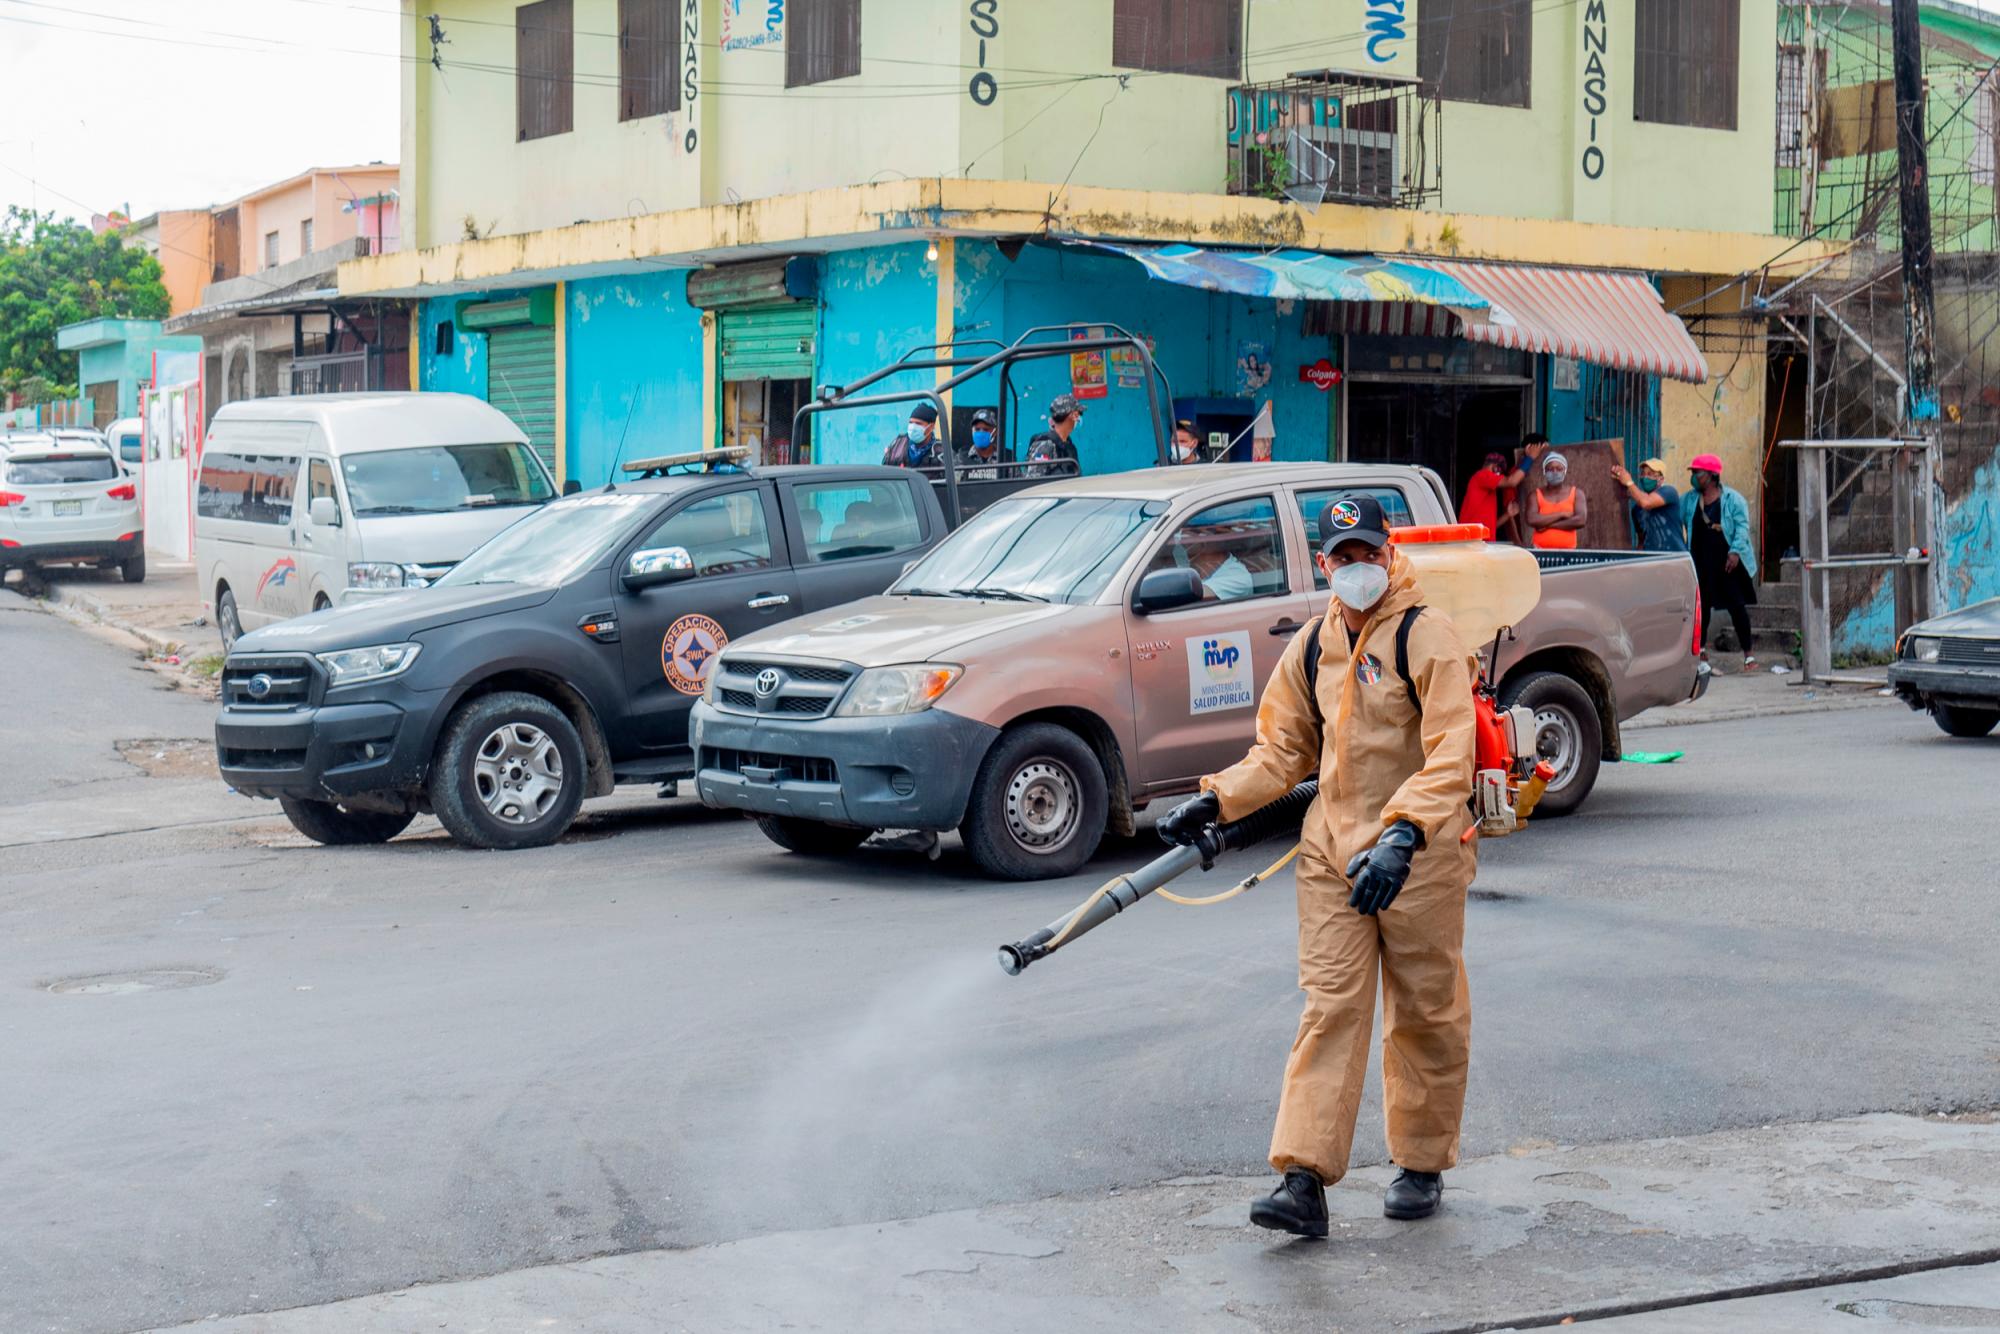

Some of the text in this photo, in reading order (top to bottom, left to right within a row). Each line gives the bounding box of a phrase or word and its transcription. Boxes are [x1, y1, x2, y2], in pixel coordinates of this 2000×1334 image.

[1307, 369, 1336, 380] Colgate
[665, 617, 726, 653] OPERACIONES
[685, 650, 707, 661] SWAT
[1201, 681, 1242, 695] MINISTERIO DE
[1193, 697, 1218, 710] SALUD
